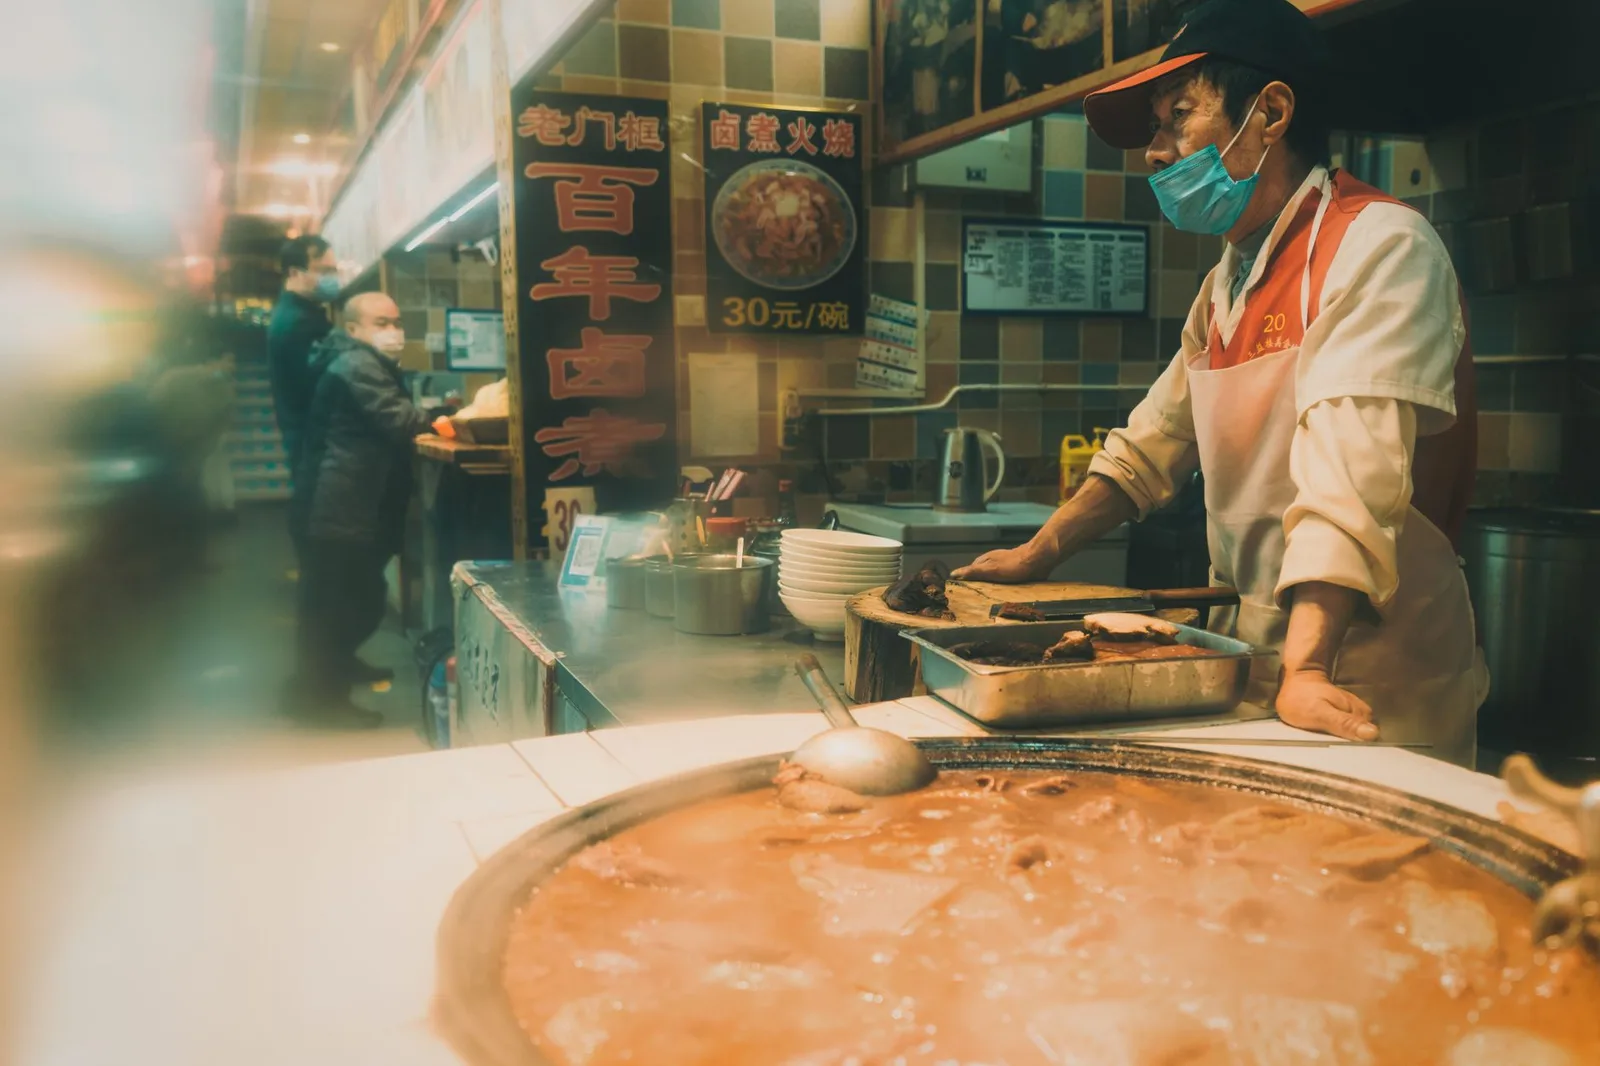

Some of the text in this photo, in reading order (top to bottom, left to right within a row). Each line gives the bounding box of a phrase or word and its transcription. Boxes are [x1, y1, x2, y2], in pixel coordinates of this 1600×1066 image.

[518, 103, 665, 151] 老门框
[710, 109, 855, 157] 卤煮火烧
[722, 296, 849, 329] 30元/碗
[1263, 313, 1286, 333] 20
